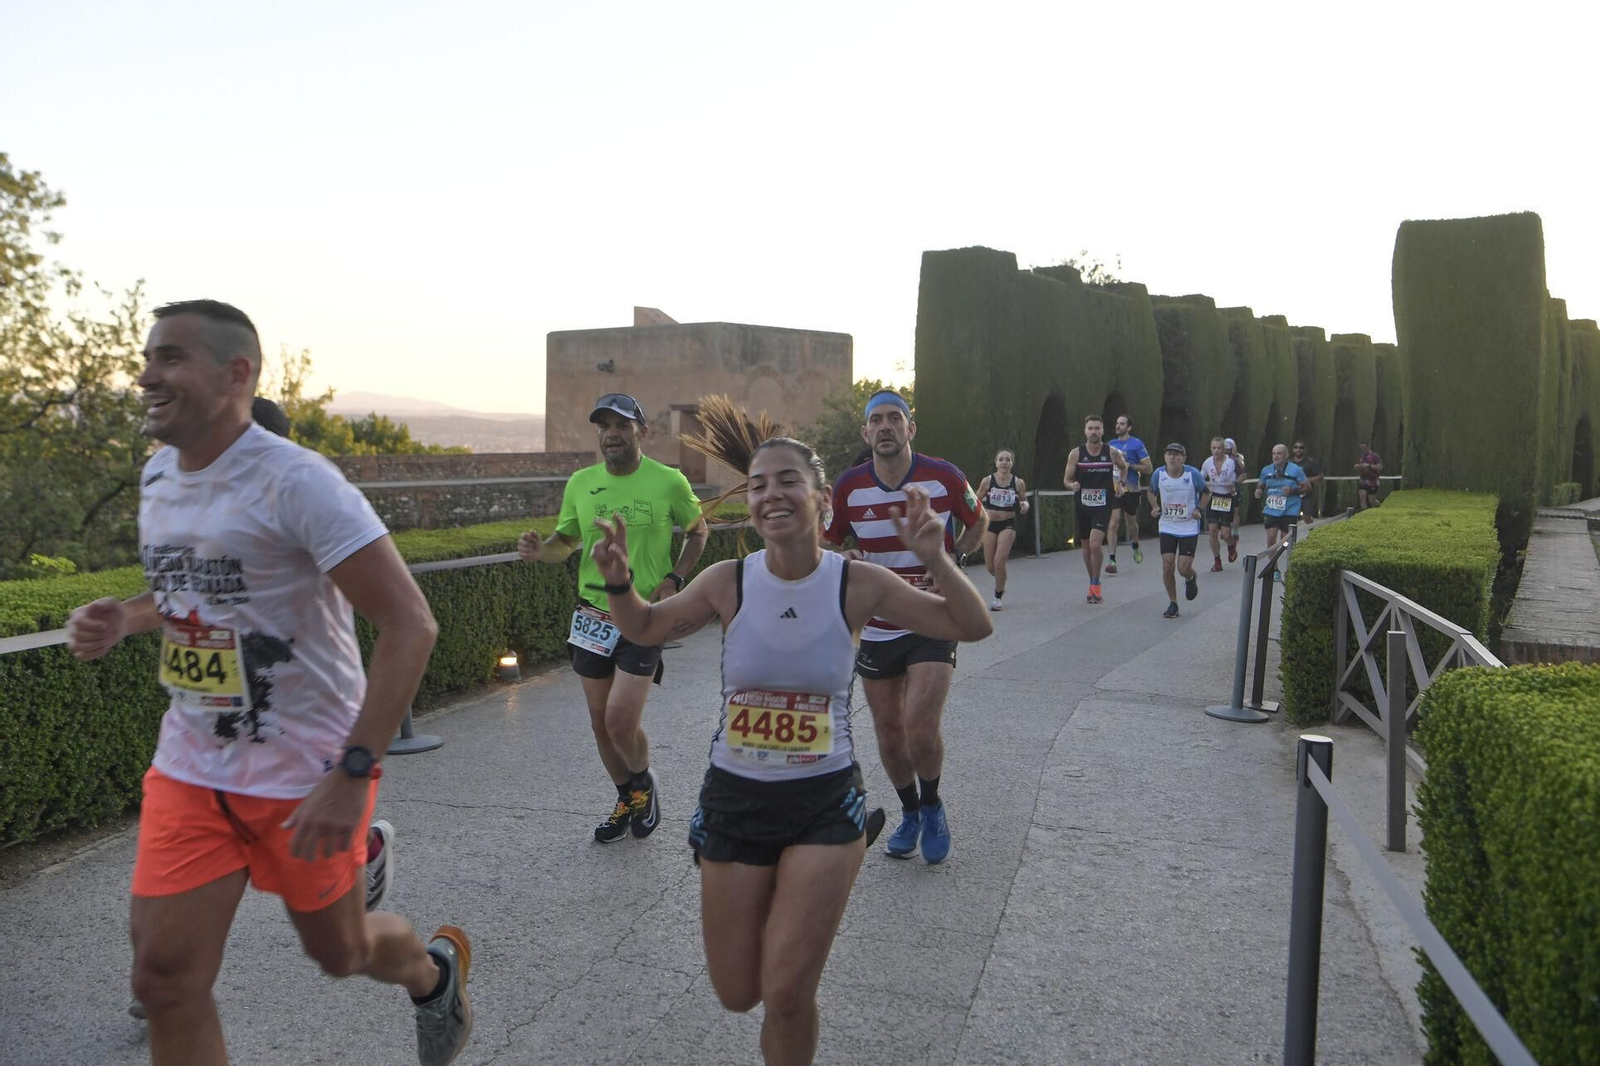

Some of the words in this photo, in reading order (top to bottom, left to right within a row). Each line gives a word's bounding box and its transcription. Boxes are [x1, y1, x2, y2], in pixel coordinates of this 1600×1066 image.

[1164, 507, 1184, 516] 3779
[574, 614, 614, 641] 5825
[730, 708, 818, 743] 4485
